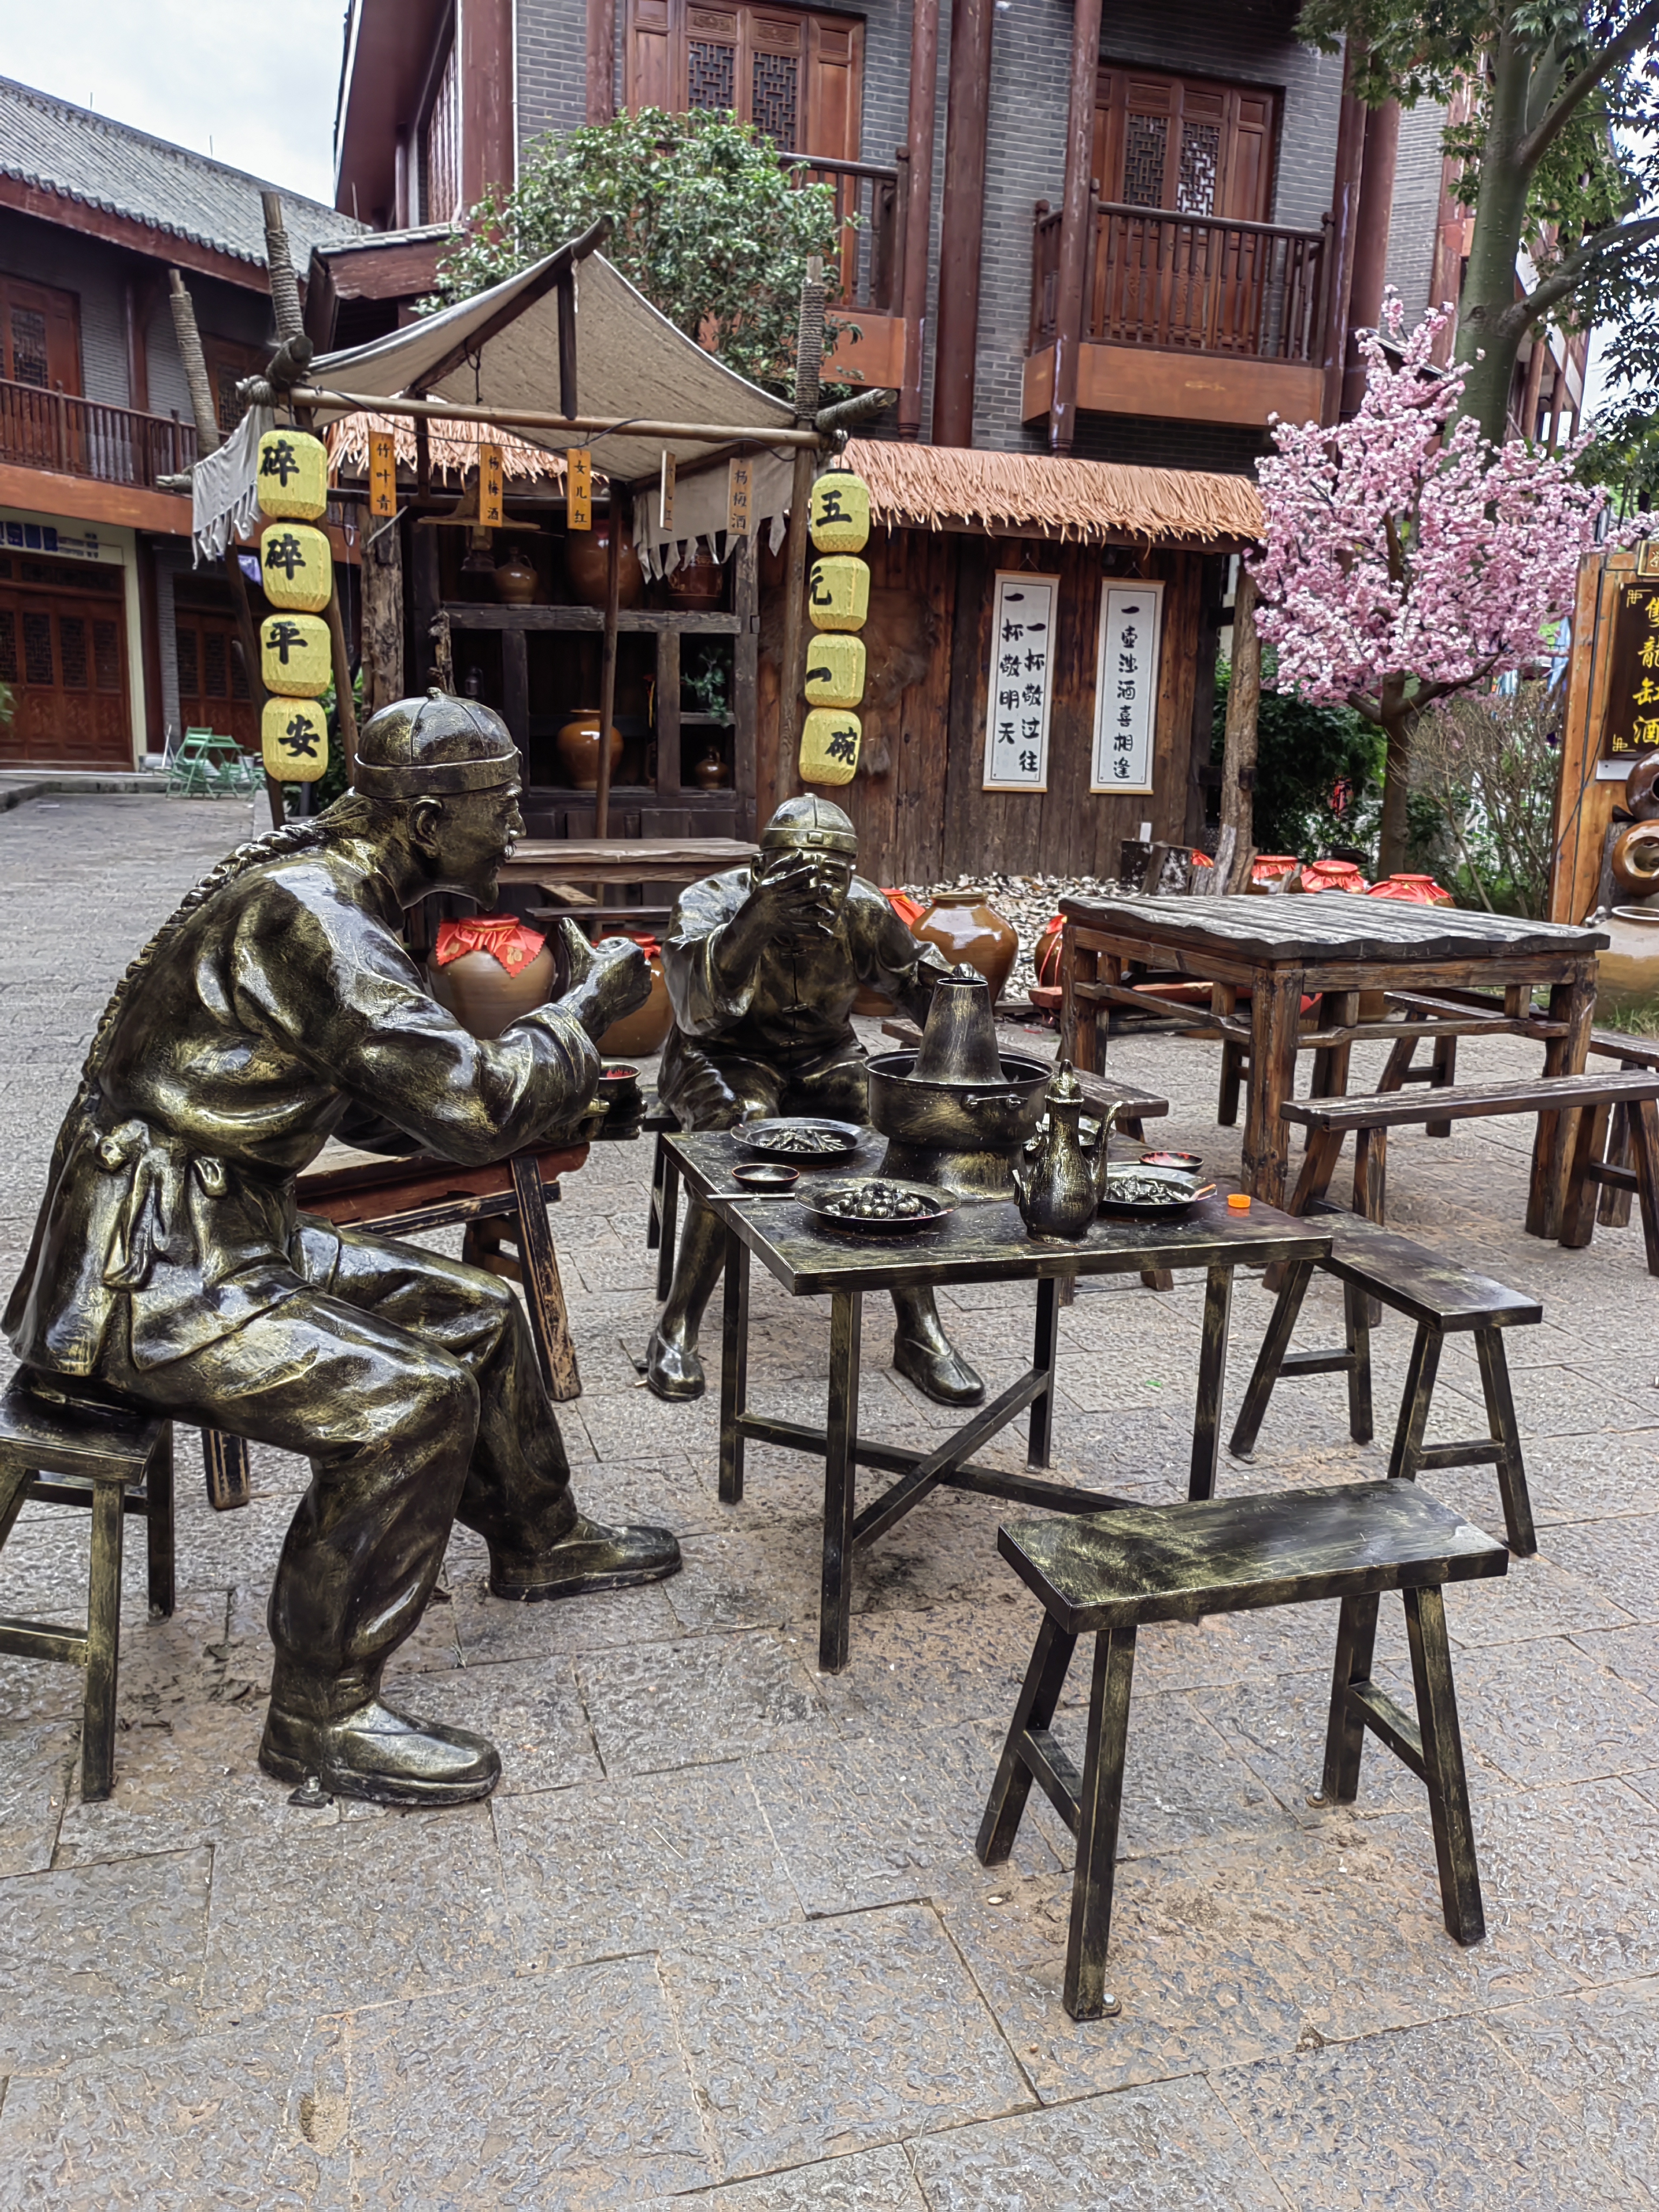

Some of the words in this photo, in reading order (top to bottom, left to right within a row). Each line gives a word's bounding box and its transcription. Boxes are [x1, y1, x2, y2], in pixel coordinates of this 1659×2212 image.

[376, 443, 391, 511] 竹叶青
[488, 455, 499, 521] 杨梅酒
[574, 460, 587, 523] 女儿红
[731, 469, 747, 529] 杨梅酒
[260, 439, 320, 758] 碎碎平安
[997, 593, 1024, 745] 一杯敬明天
[1019, 623, 1046, 773] 一杯敬过往
[1114, 606, 1140, 779] 一壶浊酒喜相逢
